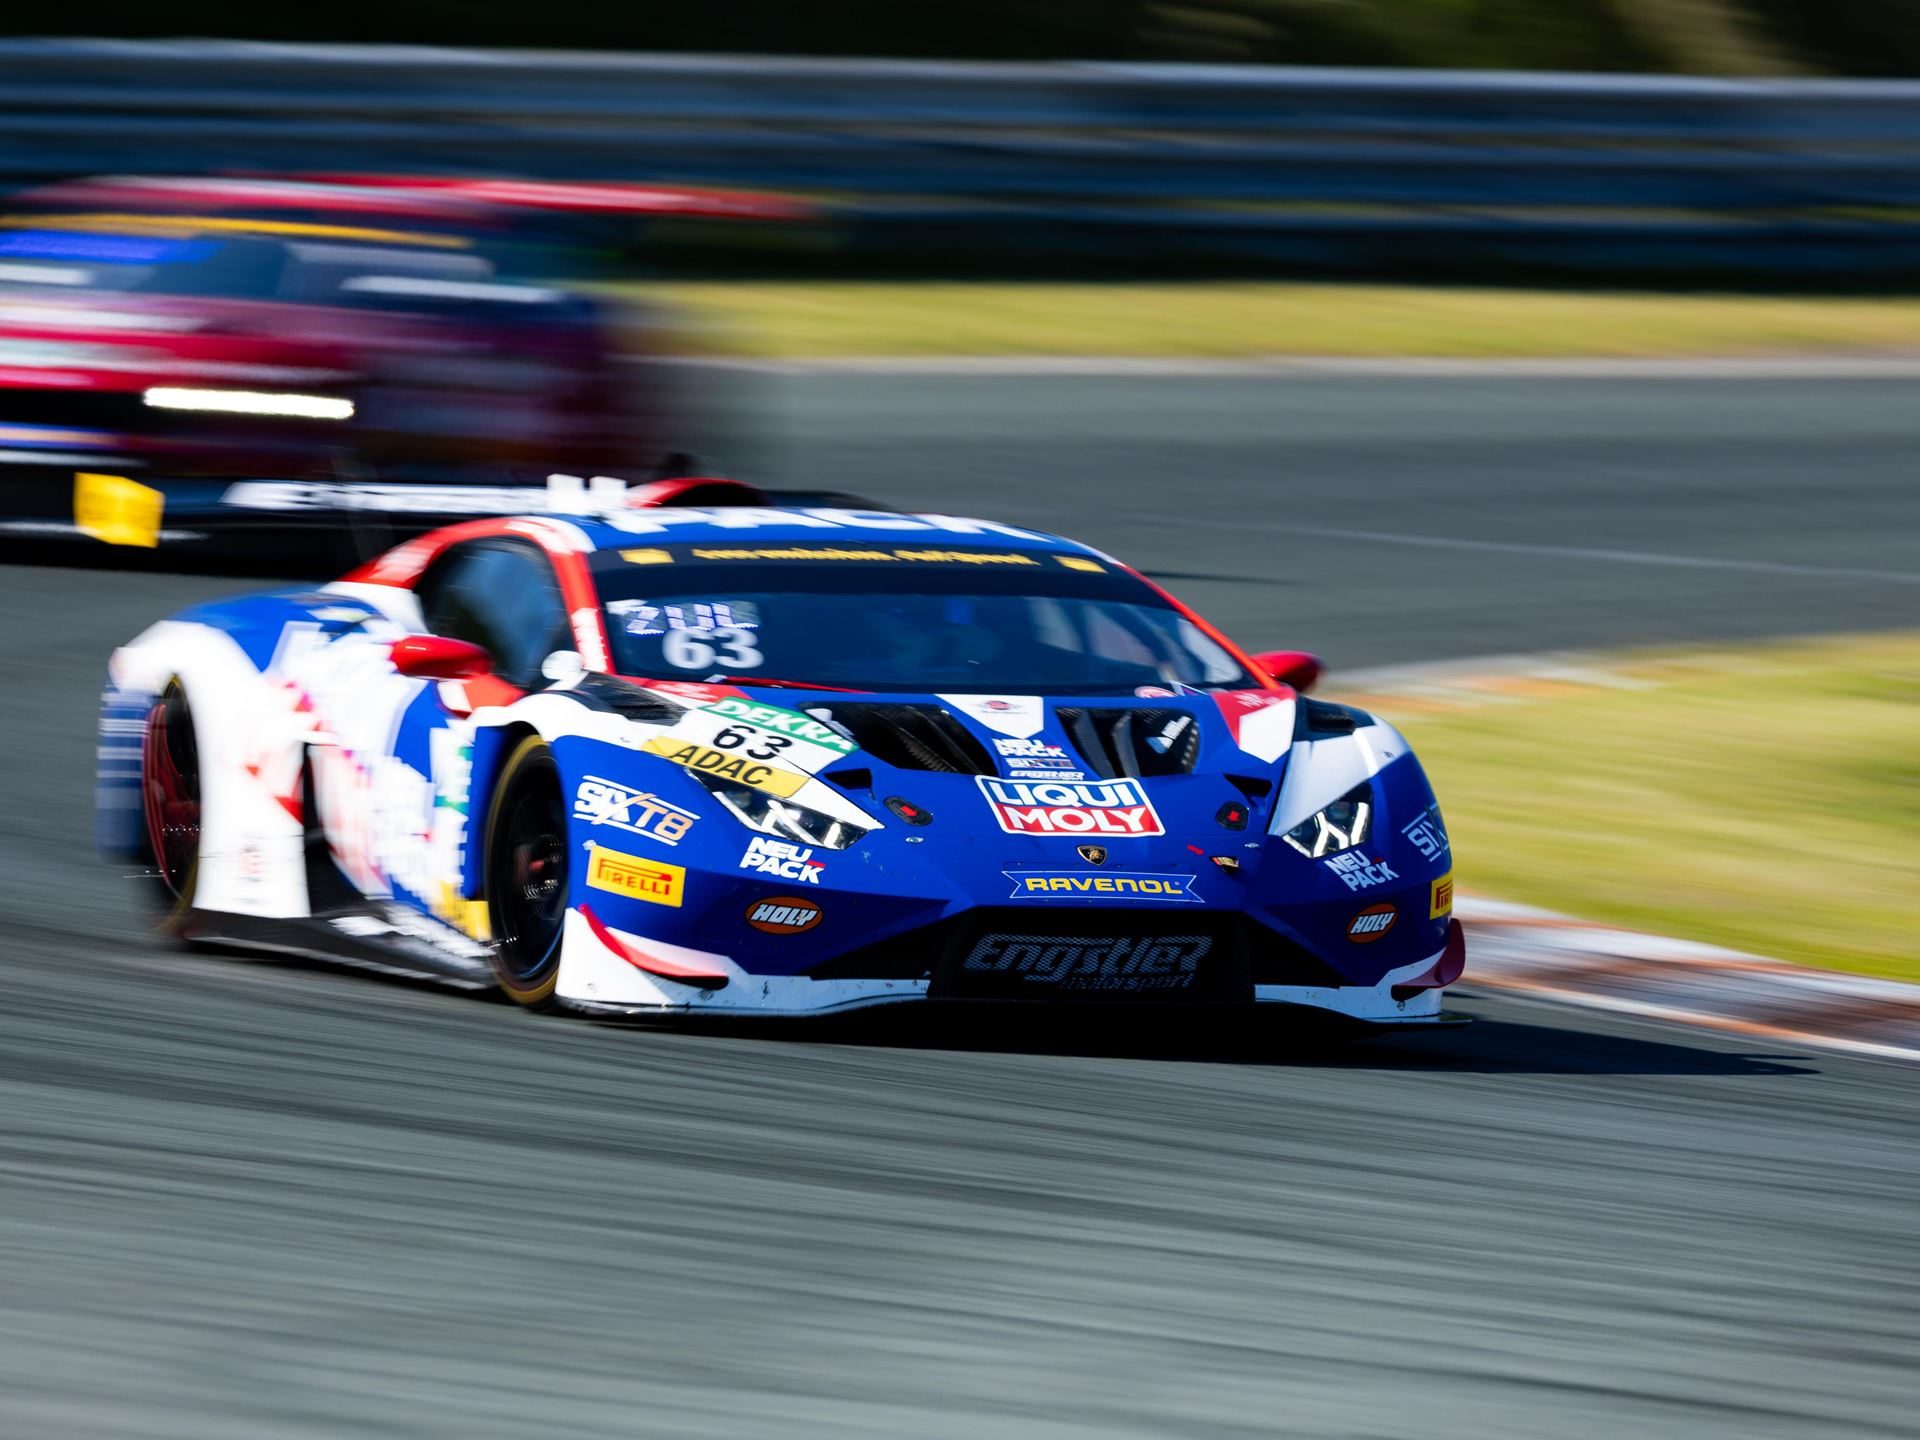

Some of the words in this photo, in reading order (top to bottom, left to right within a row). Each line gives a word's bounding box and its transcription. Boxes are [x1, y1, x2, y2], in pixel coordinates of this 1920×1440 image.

[662, 626, 765, 669] 63
[712, 699, 857, 750] DEKRA
[713, 725, 793, 759] 63
[669, 745, 773, 785] ADAC
[988, 781, 1138, 808] LIQUI
[1003, 807, 1147, 832] MOLY
[746, 836, 813, 862] NEU
[1324, 849, 1372, 876] NEU
[597, 858, 673, 896] PIRELLI
[739, 852, 825, 884] PACK
[1340, 861, 1400, 892] PACK
[1024, 877, 1183, 895] RAVENOL
[750, 903, 819, 927] HOLY
[1349, 912, 1395, 934] HOLY
